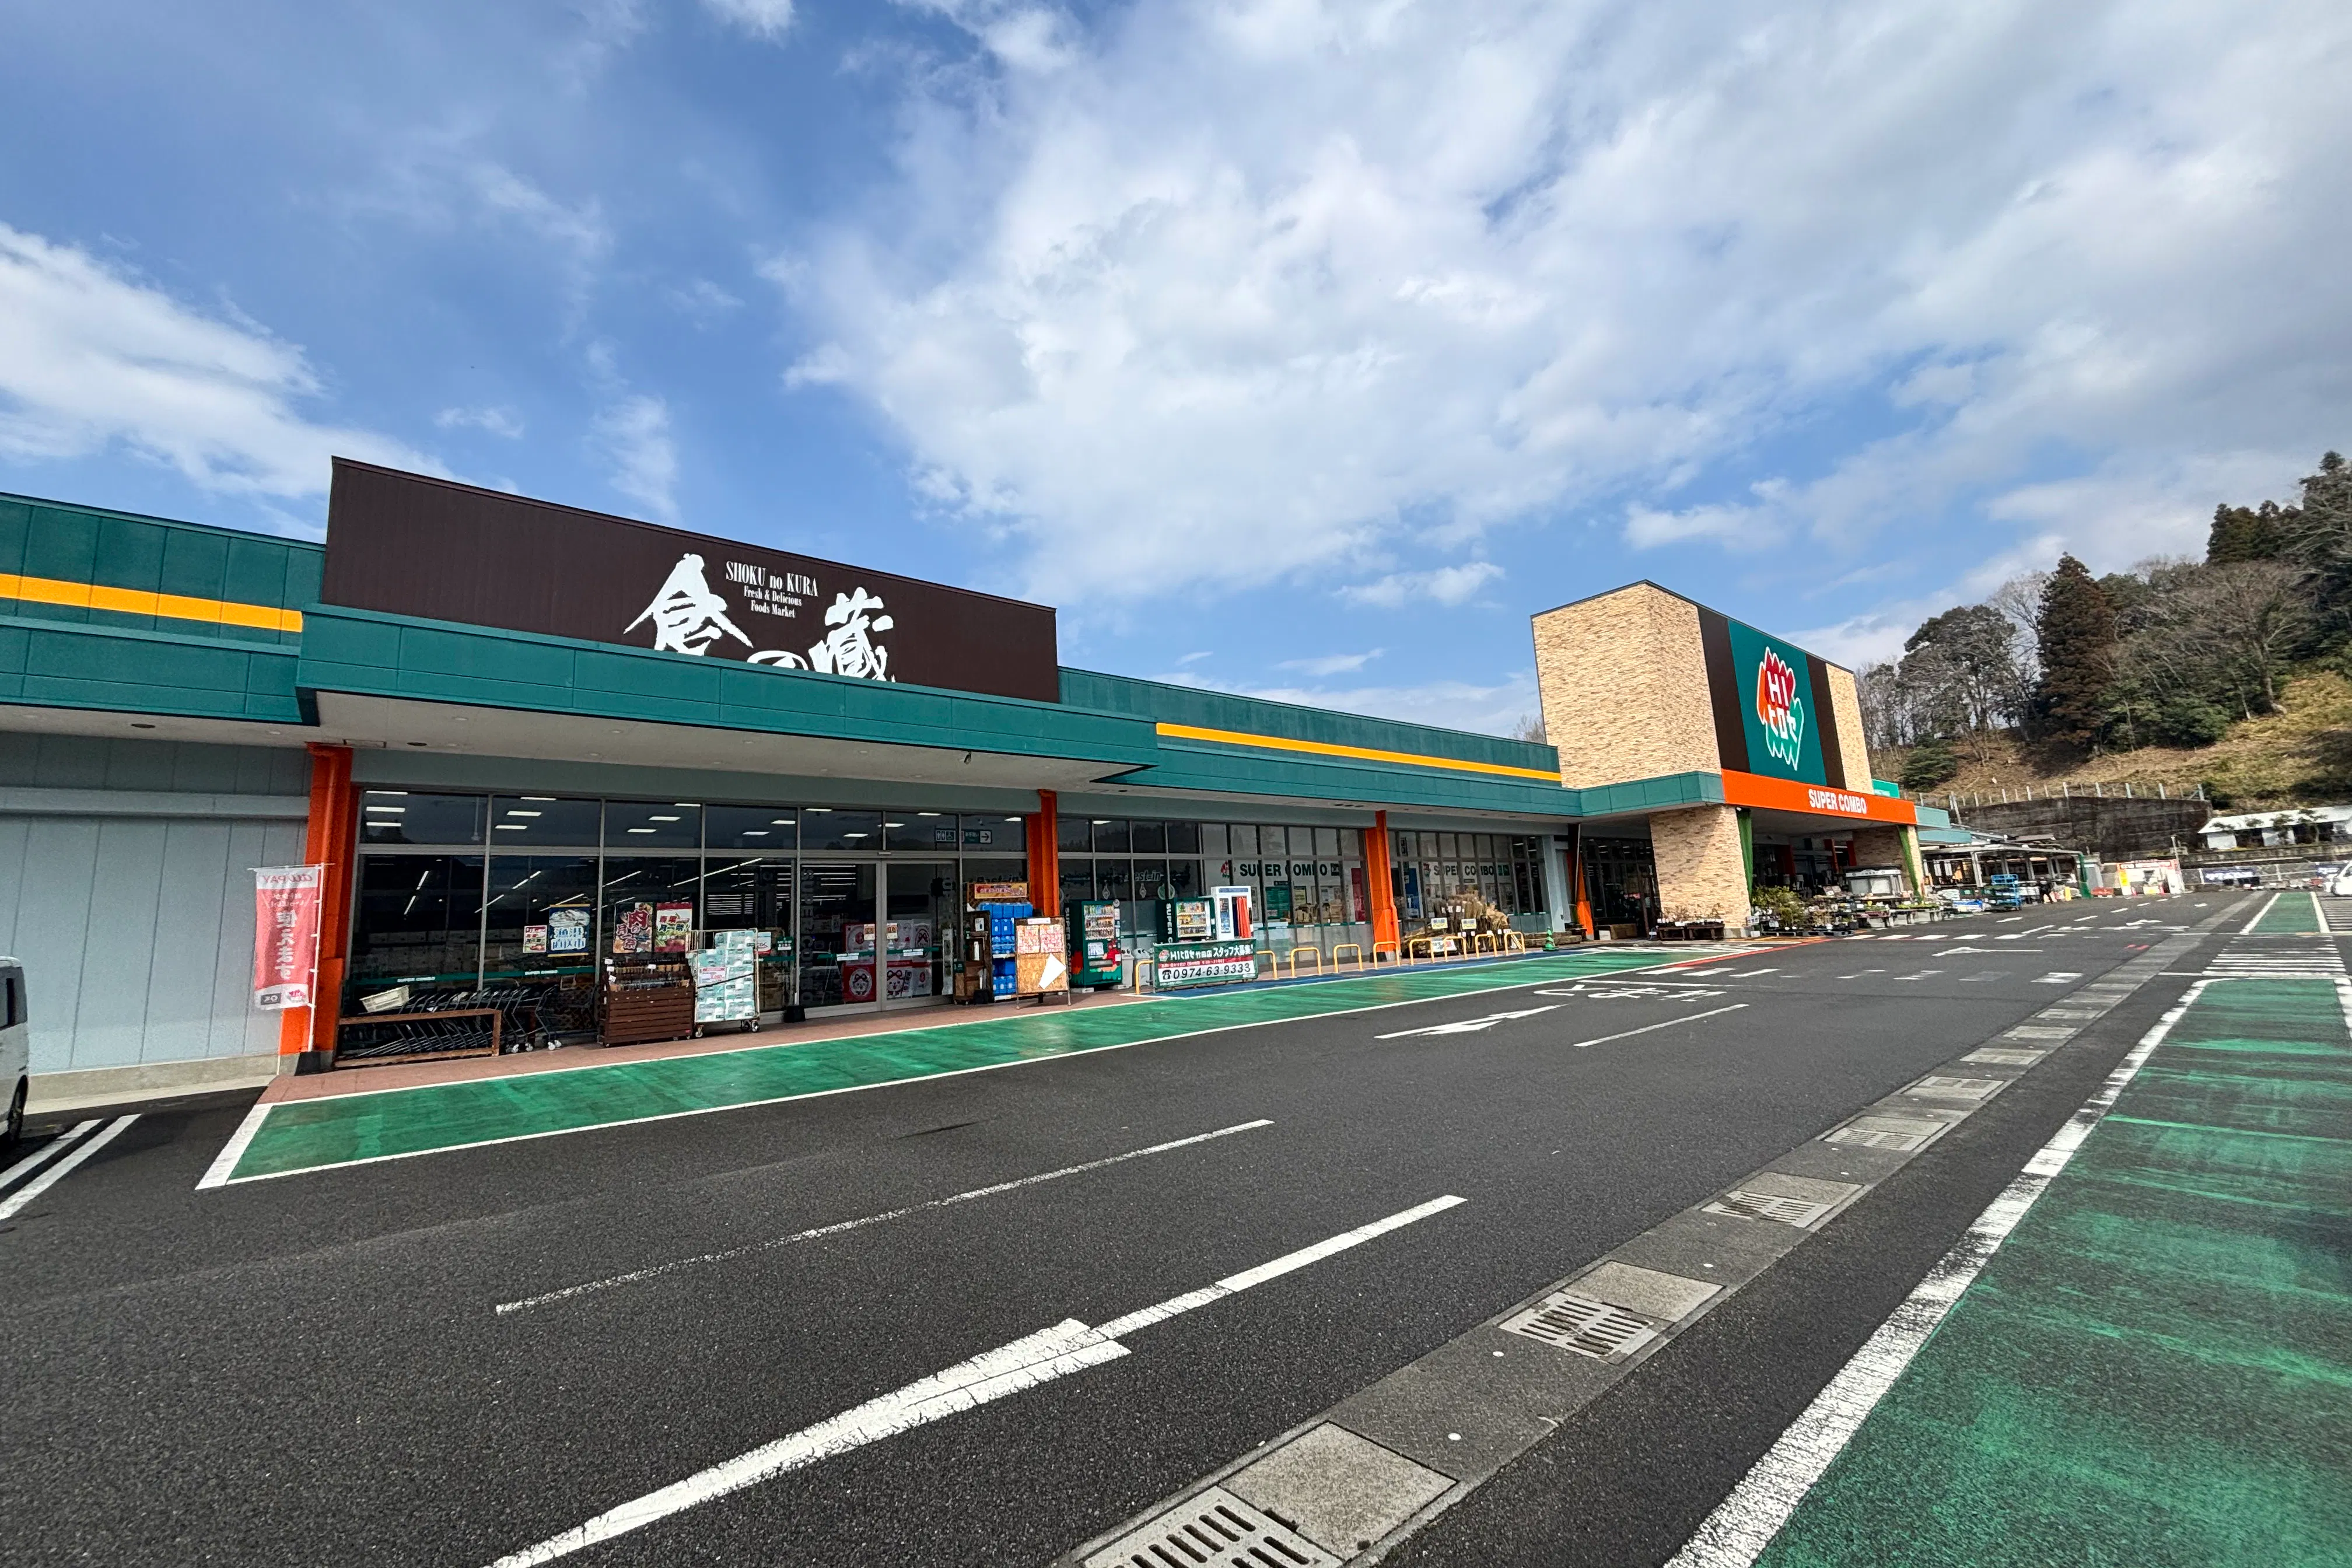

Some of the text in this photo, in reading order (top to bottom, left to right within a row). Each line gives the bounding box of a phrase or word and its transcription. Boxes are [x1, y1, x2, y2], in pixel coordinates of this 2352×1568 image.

[726, 561, 818, 597] SHOKU no KURA
[744, 585, 802, 606] Fresh & Delicious
[751, 600, 796, 618] Foods Market
[1767, 671, 1789, 707] HI
[1808, 789, 1867, 814] SUPER COMBO
[1173, 963, 1251, 979] 0974-63-9333
